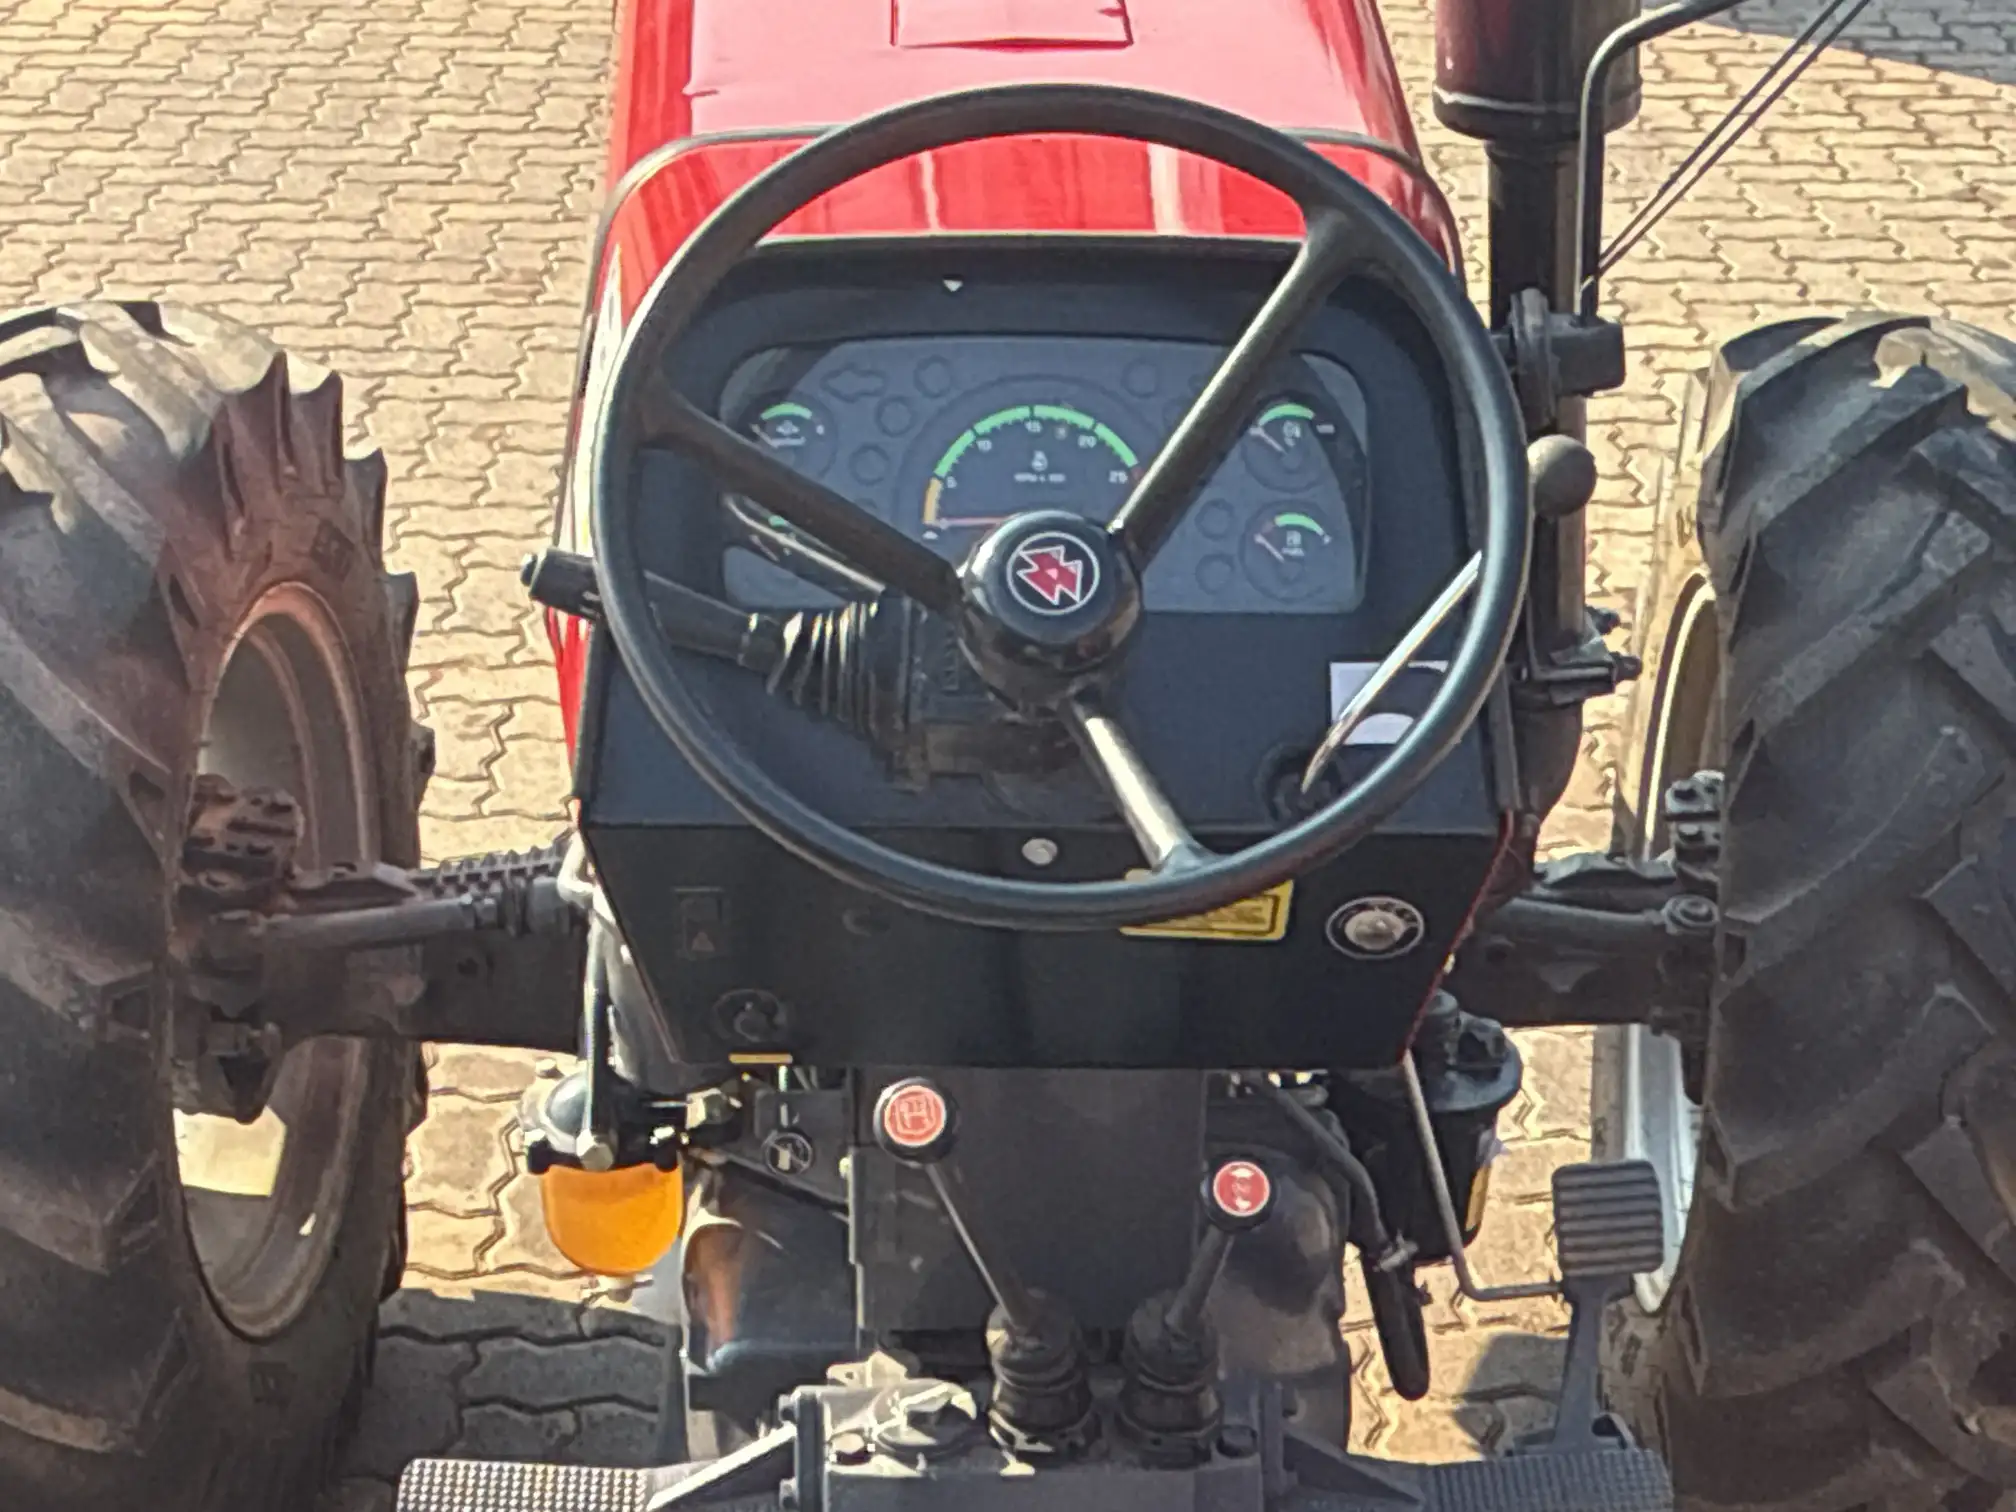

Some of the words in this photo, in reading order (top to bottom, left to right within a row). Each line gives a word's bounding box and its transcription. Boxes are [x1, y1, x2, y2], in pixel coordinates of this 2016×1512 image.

[977, 440, 992, 451] 10
[1078, 435, 1097, 448] 20
[947, 476, 957, 488] 5
[1108, 470, 1128, 483] 25
